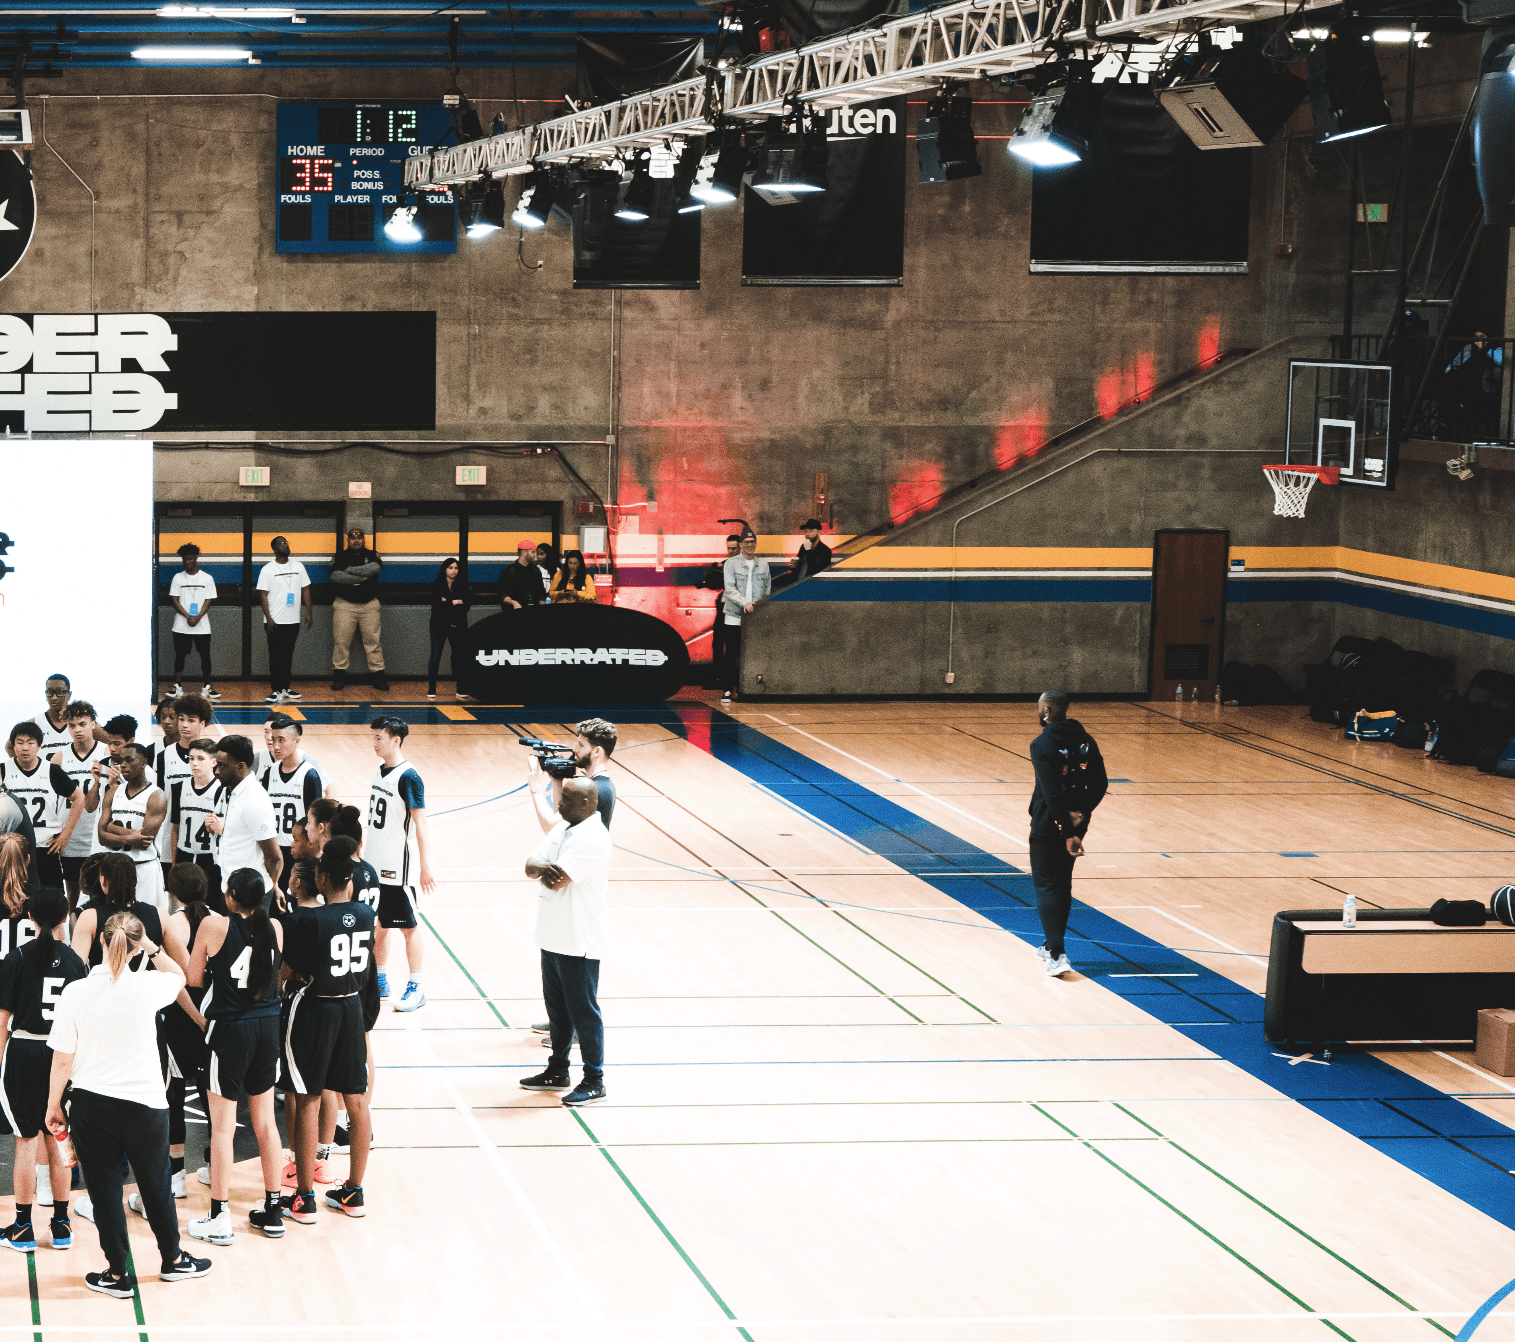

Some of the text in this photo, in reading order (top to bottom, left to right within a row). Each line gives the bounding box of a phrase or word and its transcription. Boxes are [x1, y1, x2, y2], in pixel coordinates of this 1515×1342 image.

[356, 110, 417, 142] 1:12
[287, 146, 325, 156] HOME
[349, 148, 385, 156] PERIOD
[292, 159, 333, 192] 35
[353, 170, 382, 179] POSS.
[351, 181, 384, 190] BONUS
[280, 195, 312, 203] FOULS
[335, 195, 370, 203] PLAYER
[244, 468, 265, 484] EXIT
[461, 467, 481, 483] EXIT
[475, 647, 669, 667] UNDERRATED
[184, 816, 211, 851] 14
[330, 930, 372, 978] 95
